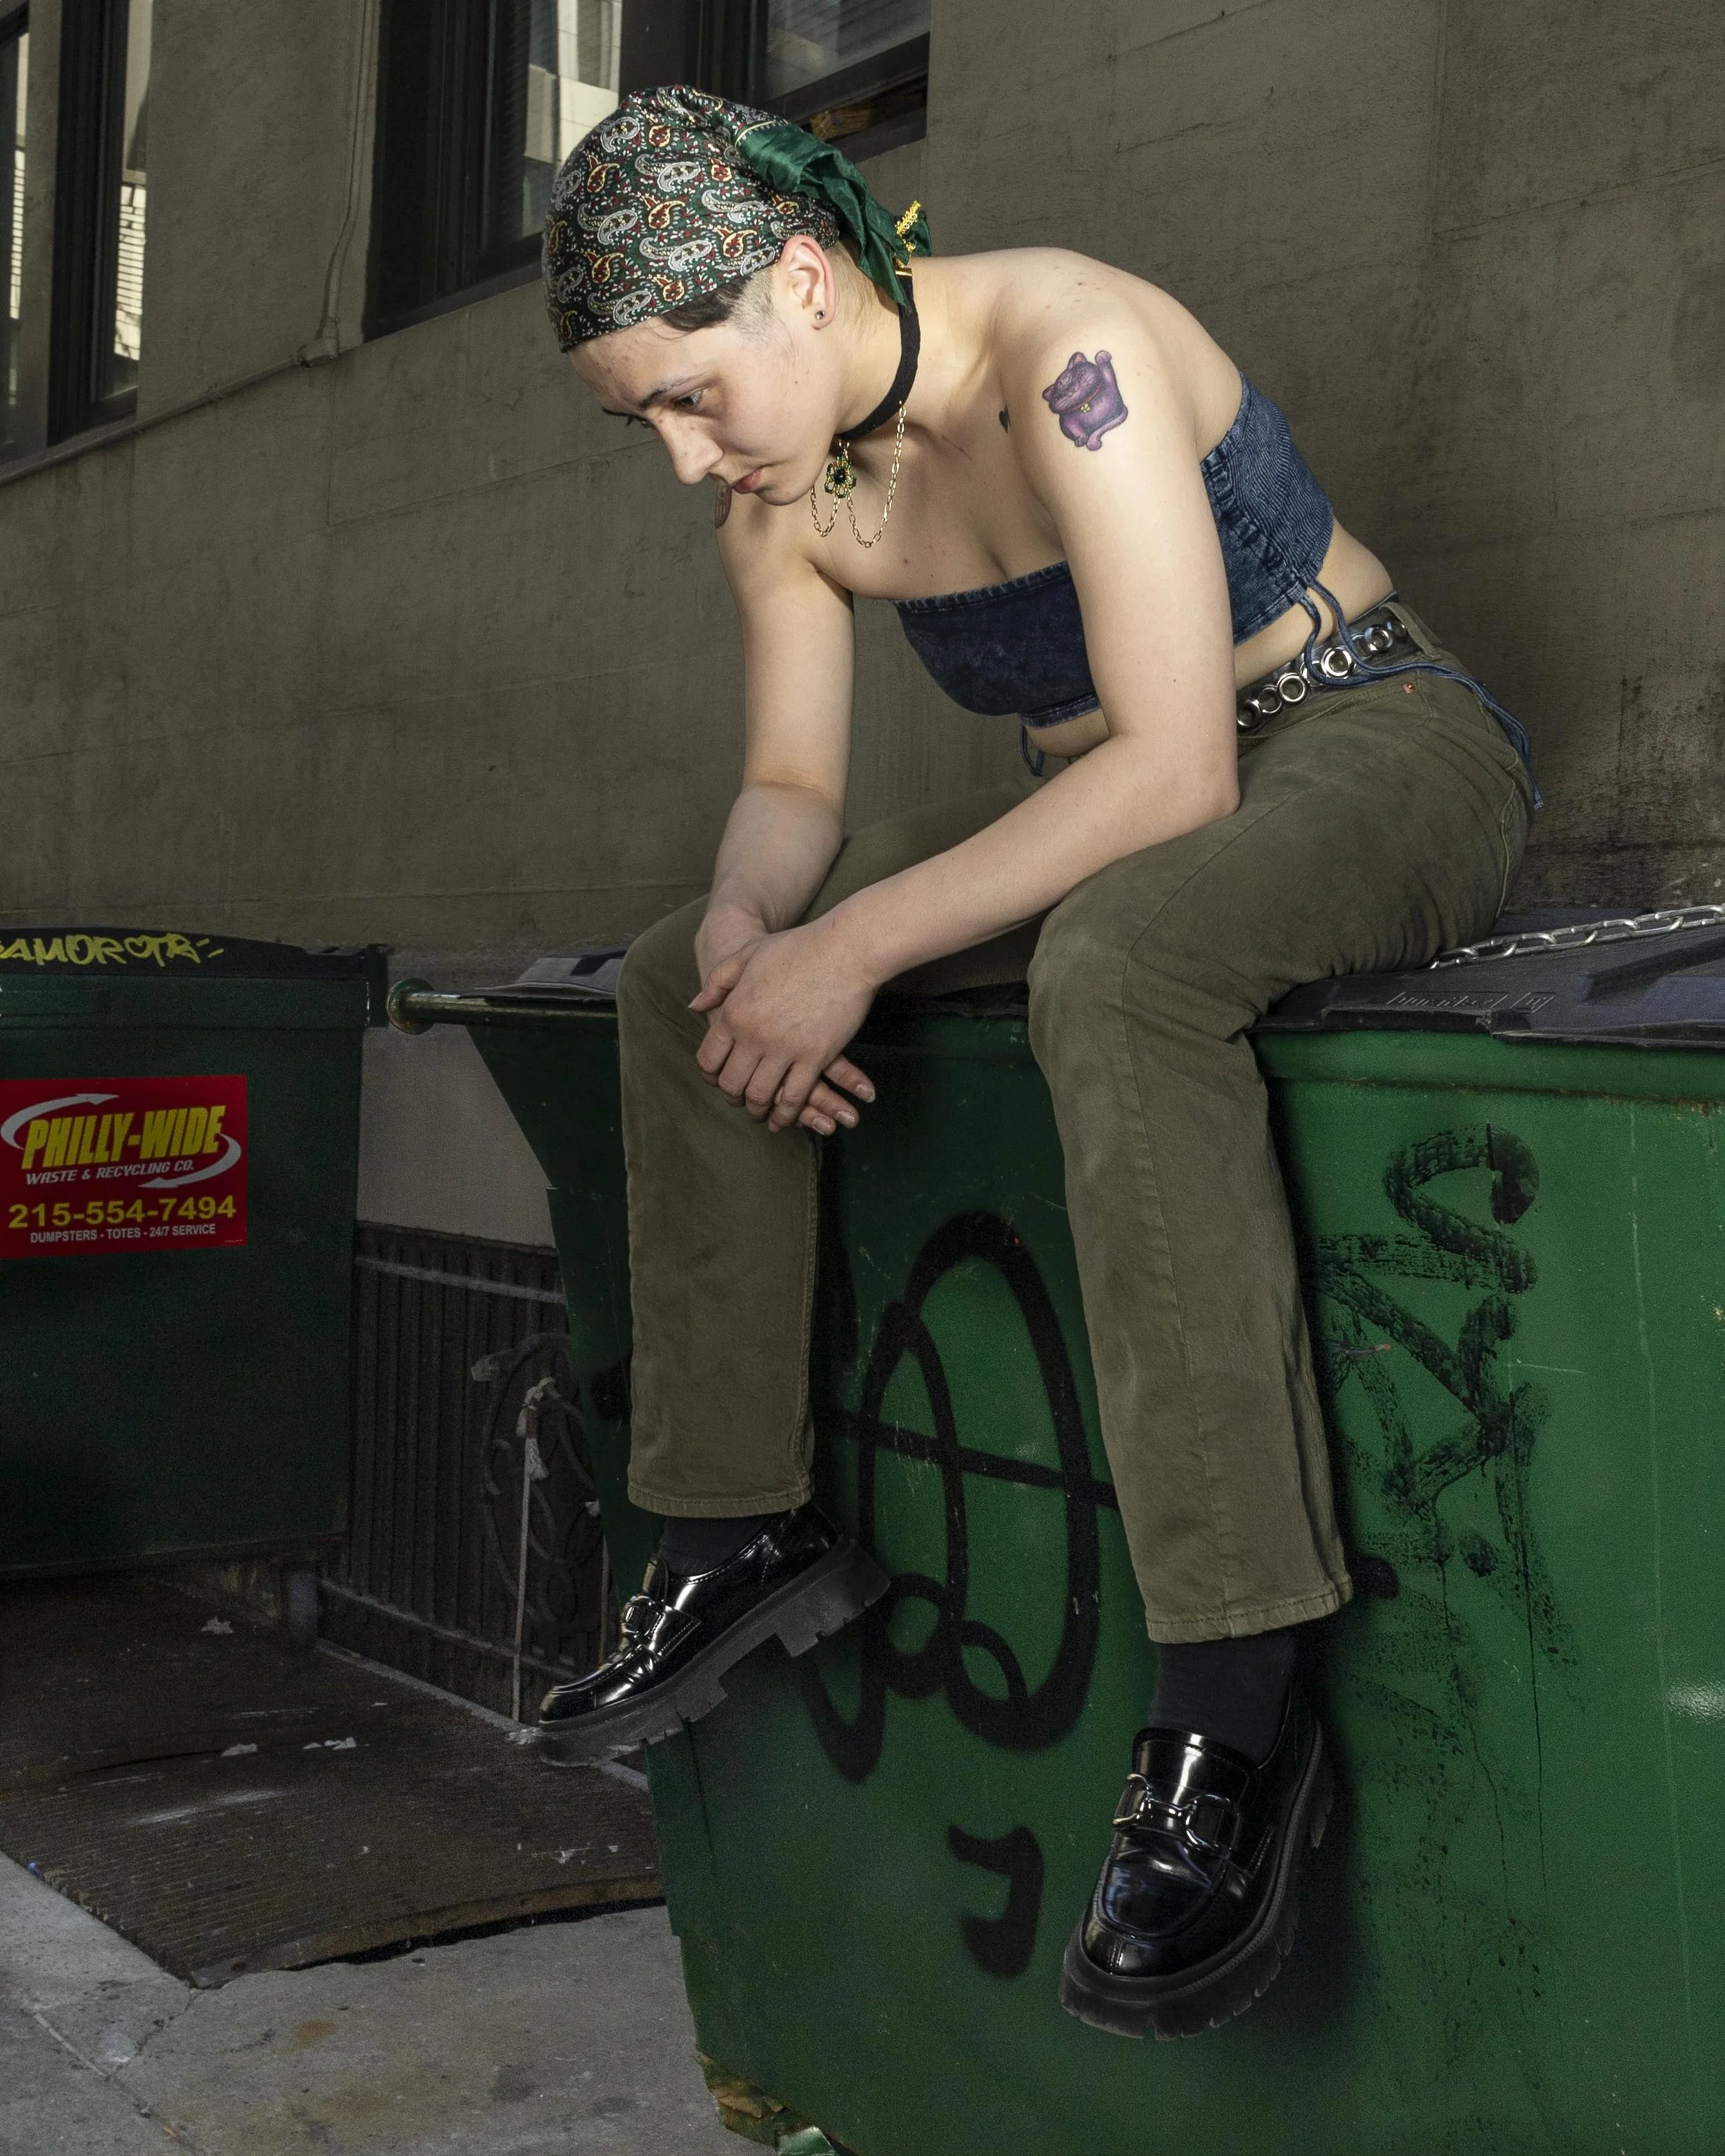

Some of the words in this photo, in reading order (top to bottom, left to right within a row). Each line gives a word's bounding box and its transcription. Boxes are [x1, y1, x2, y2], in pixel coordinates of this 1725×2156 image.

[21, 1105, 227, 1170] PHILLY-WIDE
[26, 1169, 76, 1185] WASTE
[81, 1169, 91, 1180] &
[96, 1161, 171, 1179] RECYCLING
[174, 1159, 194, 1172] CO.
[8, 1195, 237, 1229] 215-554-7494
[30, 1227, 97, 1243] DUMPSTERS
[107, 1227, 141, 1240] TOTES
[149, 1225, 169, 1238] 24/7
[172, 1223, 216, 1236] SERVICE
